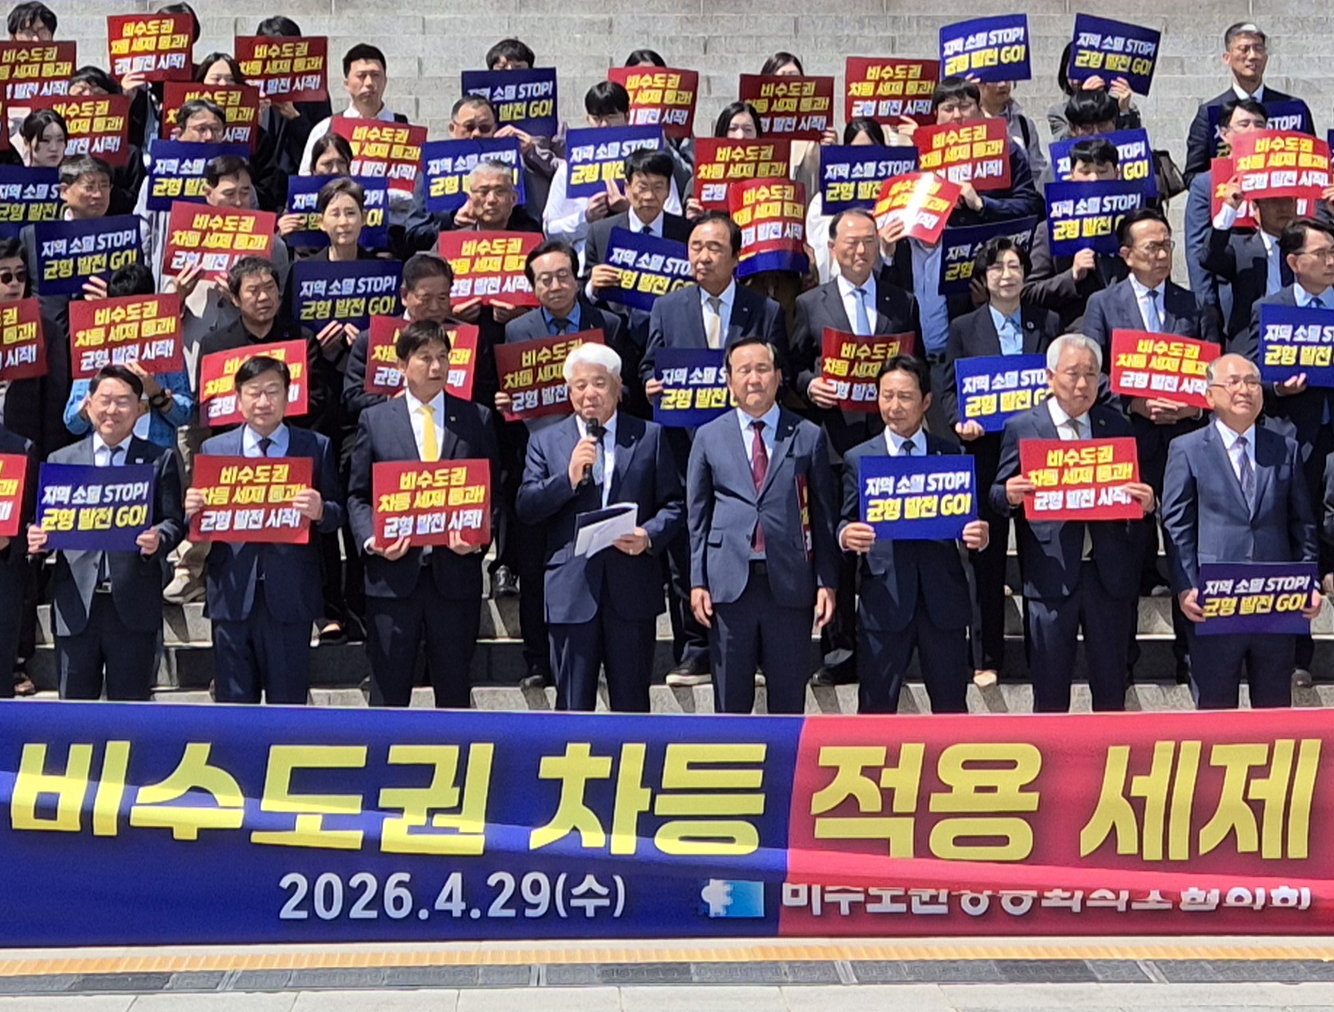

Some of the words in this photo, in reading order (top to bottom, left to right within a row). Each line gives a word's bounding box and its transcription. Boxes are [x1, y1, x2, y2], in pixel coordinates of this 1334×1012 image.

[944, 38, 964, 56] 지역
[964, 32, 987, 50] 소멸
[989, 27, 1024, 45] STOP!
[1077, 33, 1101, 48] 지역
[1102, 36, 1124, 50] 소멸
[1126, 39, 1155, 54] STOP!
[946, 56, 969, 75] 균형
[971, 50, 998, 68] 발전
[1000, 47, 1025, 63] GO!
[1074, 51, 1104, 69] 균형
[1106, 56, 1131, 71] 발전
[1132, 60, 1152, 75] GO!
[867, 66, 921, 80] 비수도권
[300, 281, 326, 296] 지역
[329, 279, 355, 294] 소멸
[357, 277, 396, 293] STOP!
[95, 302, 160, 324] 비수도권
[299, 302, 333, 320] 균형
[337, 300, 365, 317] 발전
[370, 298, 394, 315] GO!
[76, 328, 105, 347] 차등
[108, 323, 139, 341] 세제
[141, 318, 176, 337] 통과!
[1264, 325, 1292, 341] 지역
[1293, 325, 1321, 342] 소멸
[81, 349, 110, 370] 균형
[142, 339, 174, 360] 시작!
[1267, 346, 1297, 365] 균형
[1302, 348, 1332, 366] 발전
[1048, 446, 1113, 467] 비수도권
[220, 466, 289, 484] 비수도권
[401, 468, 466, 490] 비수도권
[865, 476, 894, 495] 지역
[896, 474, 925, 494] 소멸
[927, 472, 970, 491] STOP!
[1062, 467, 1094, 484] 세제
[1096, 463, 1133, 483] 통과!
[42, 486, 71, 504] 지역
[72, 485, 102, 504] 소멸
[103, 482, 149, 502] STOP!
[232, 486, 266, 504] 세제
[379, 493, 411, 512] 차등
[414, 490, 446, 508] 세제
[448, 486, 485, 506] 통과!
[1034, 491, 1063, 510] 균형
[1066, 488, 1095, 509] 발전
[41, 510, 75, 532] 균형
[79, 510, 113, 530] 발전
[117, 507, 146, 527] GO!
[201, 510, 232, 531] 균형
[233, 509, 265, 530] 발전
[266, 506, 303, 527] 시작!
[869, 501, 901, 522] 균형
[906, 498, 937, 519] 발전
[941, 496, 971, 515] GO!
[384, 516, 414, 540] 균형
[417, 512, 446, 534] 발전
[448, 509, 482, 530] 시작!
[1204, 580, 1233, 594] 지역
[1235, 578, 1265, 593] 소멸
[1266, 576, 1310, 591] STOP!
[1204, 599, 1237, 617] 균형
[1241, 596, 1273, 614] 발전
[1277, 595, 1306, 611] GO!
[12, 743, 493, 854] 비수도권
[532, 745, 766, 855] 차등
[812, 744, 1041, 860] 적용
[1081, 740, 1320, 860] 세제
[280, 872, 624, 919] 2026.4.29(수)
